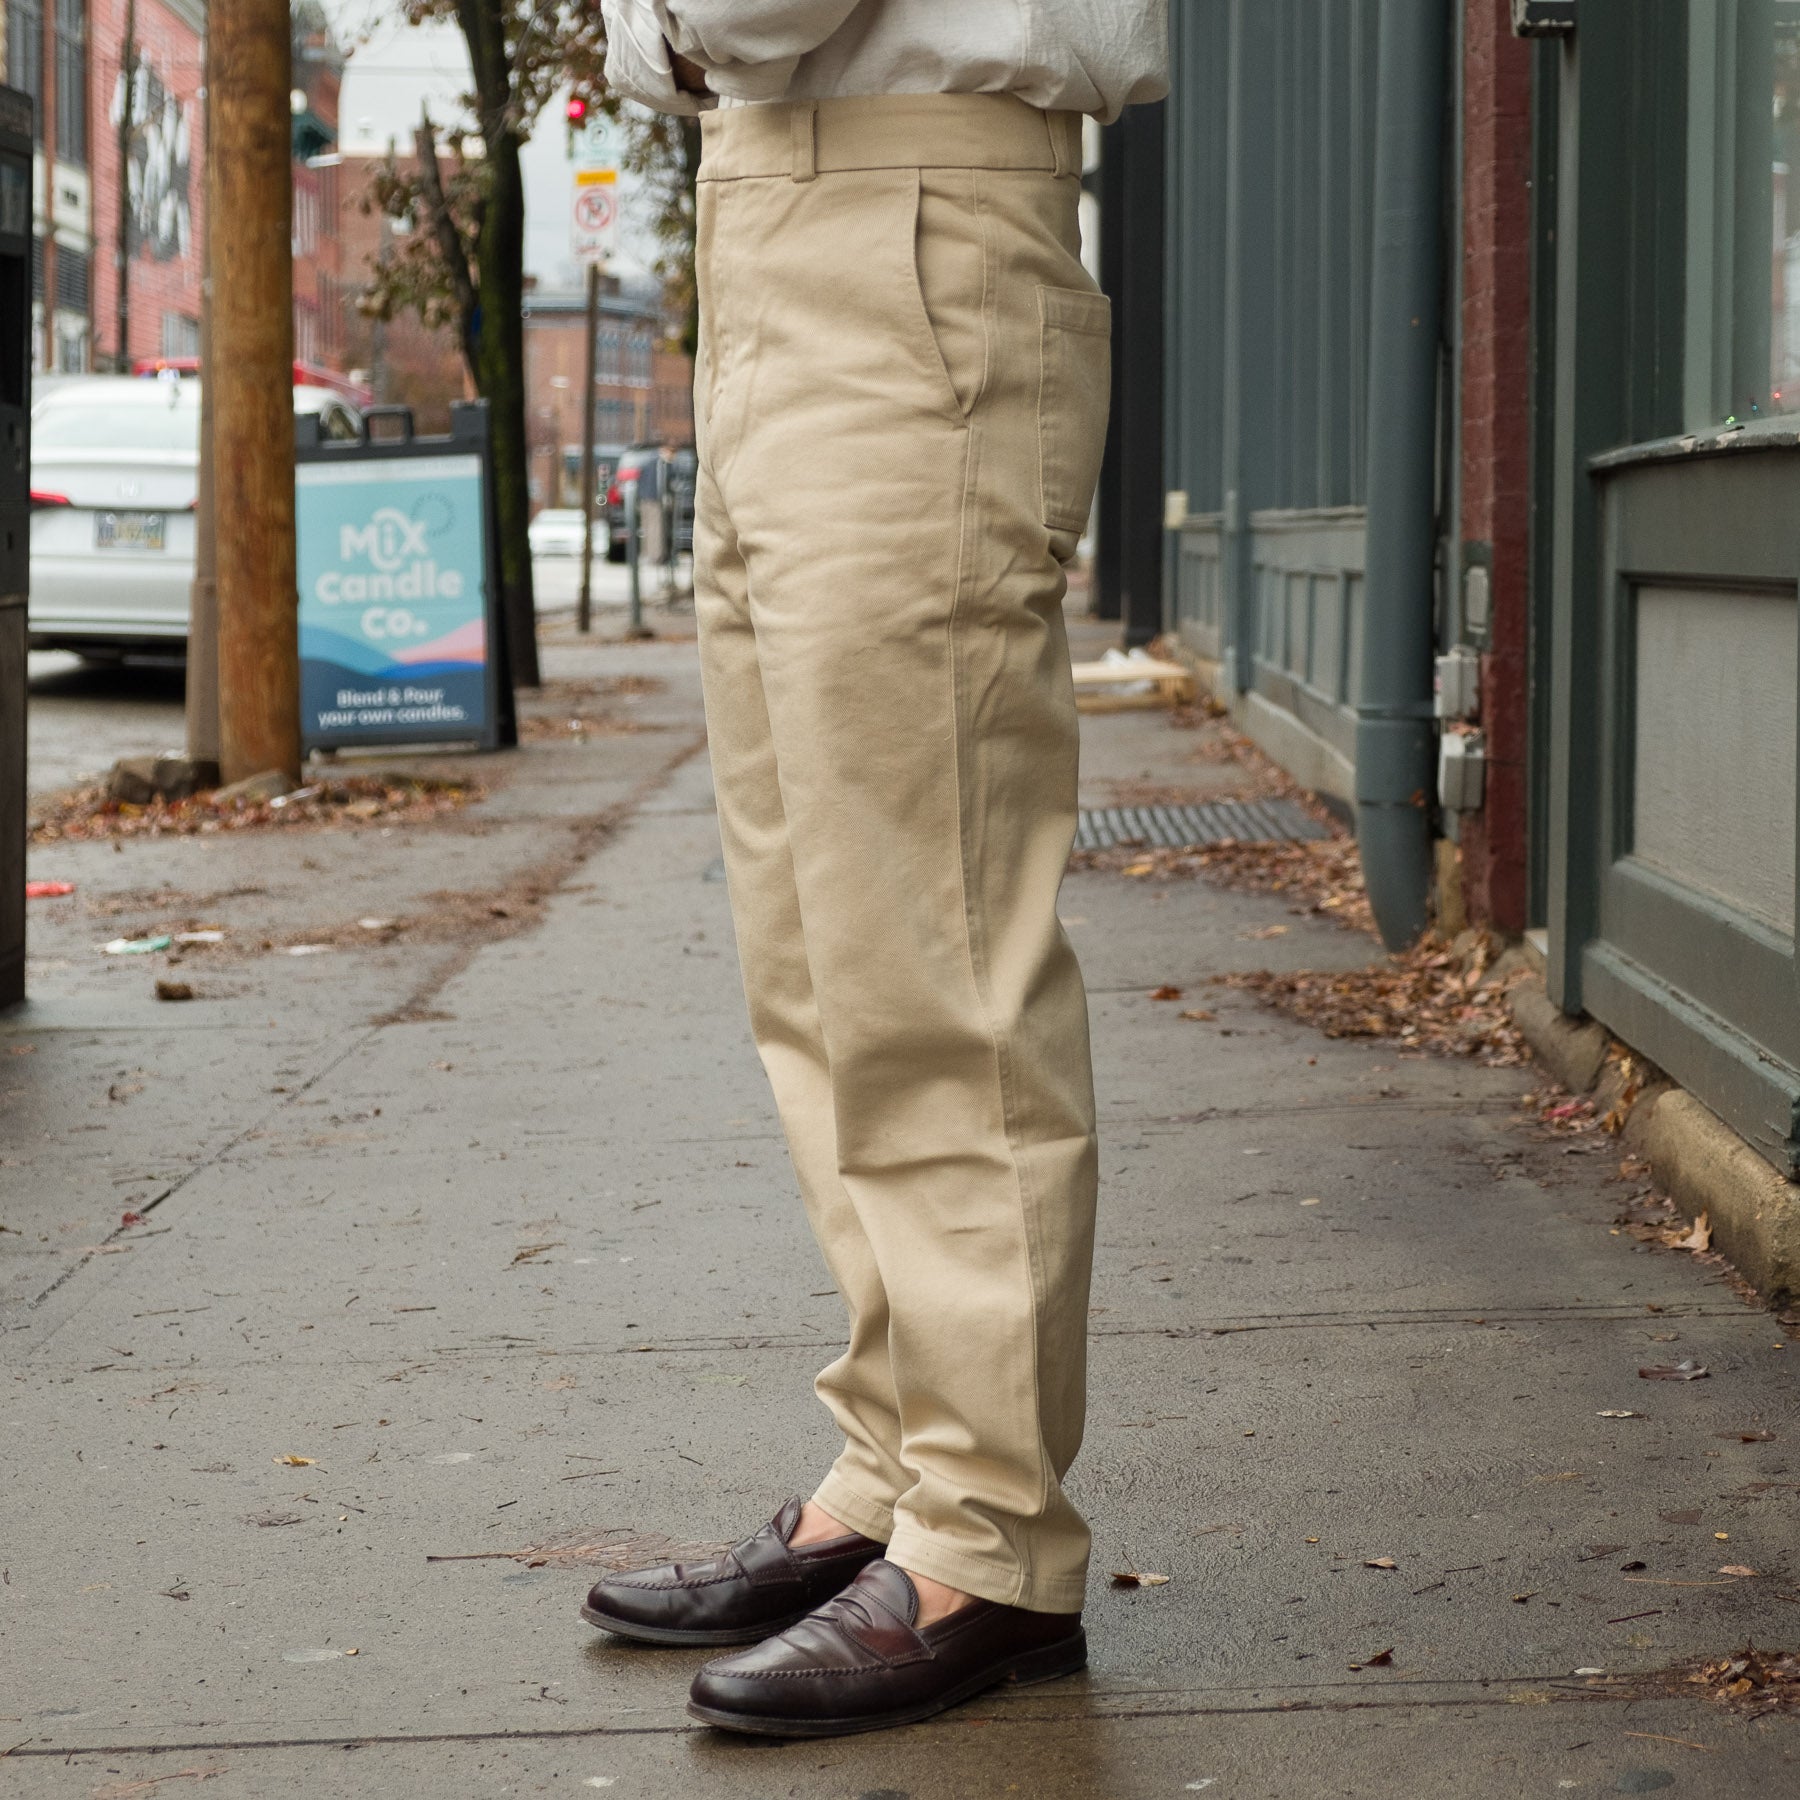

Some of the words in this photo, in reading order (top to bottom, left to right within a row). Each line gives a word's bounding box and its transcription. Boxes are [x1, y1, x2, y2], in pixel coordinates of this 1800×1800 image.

[337, 688, 386, 708] Blend
[388, 687, 401, 706] &
[404, 685, 444, 705] Pour
[318, 710, 356, 730] your
[358, 708, 393, 726] own
